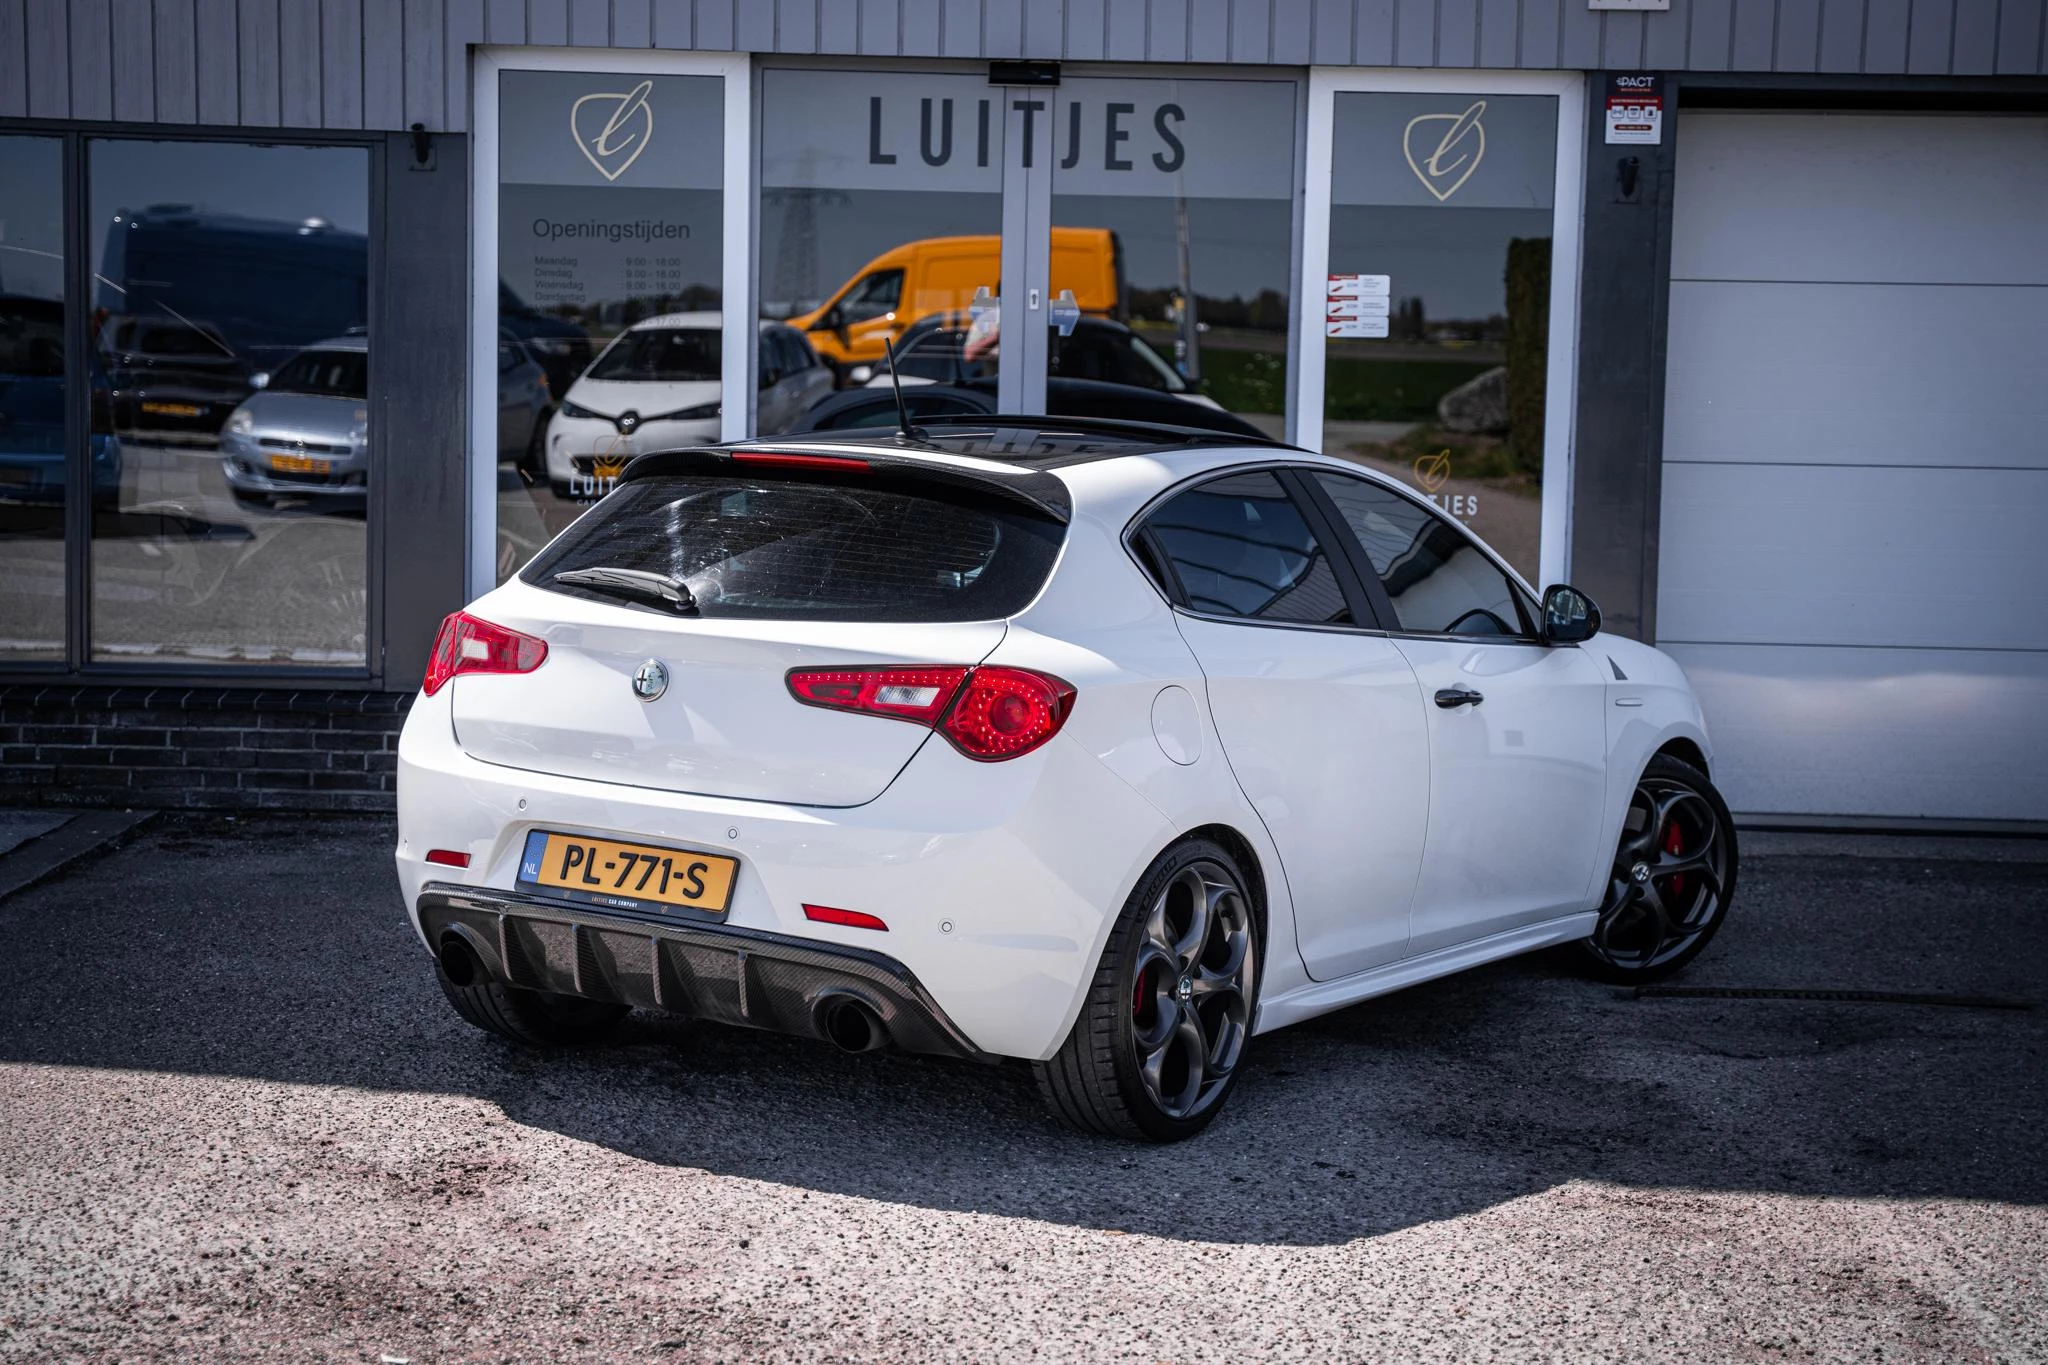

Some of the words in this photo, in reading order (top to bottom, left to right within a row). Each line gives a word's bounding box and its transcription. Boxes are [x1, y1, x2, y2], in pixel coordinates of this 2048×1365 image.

[869, 96, 1186, 173] LUITJES
[533, 218, 691, 243] Openingstijden
[534, 256, 578, 268] Maandag
[534, 268, 573, 279] Dinsdag
[534, 280, 584, 292] Woensdag
[570, 475, 616, 496] LUIT
[1427, 494, 1478, 516] TJES
[524, 861, 537, 876] NL
[560, 844, 708, 900] PL-771-S
